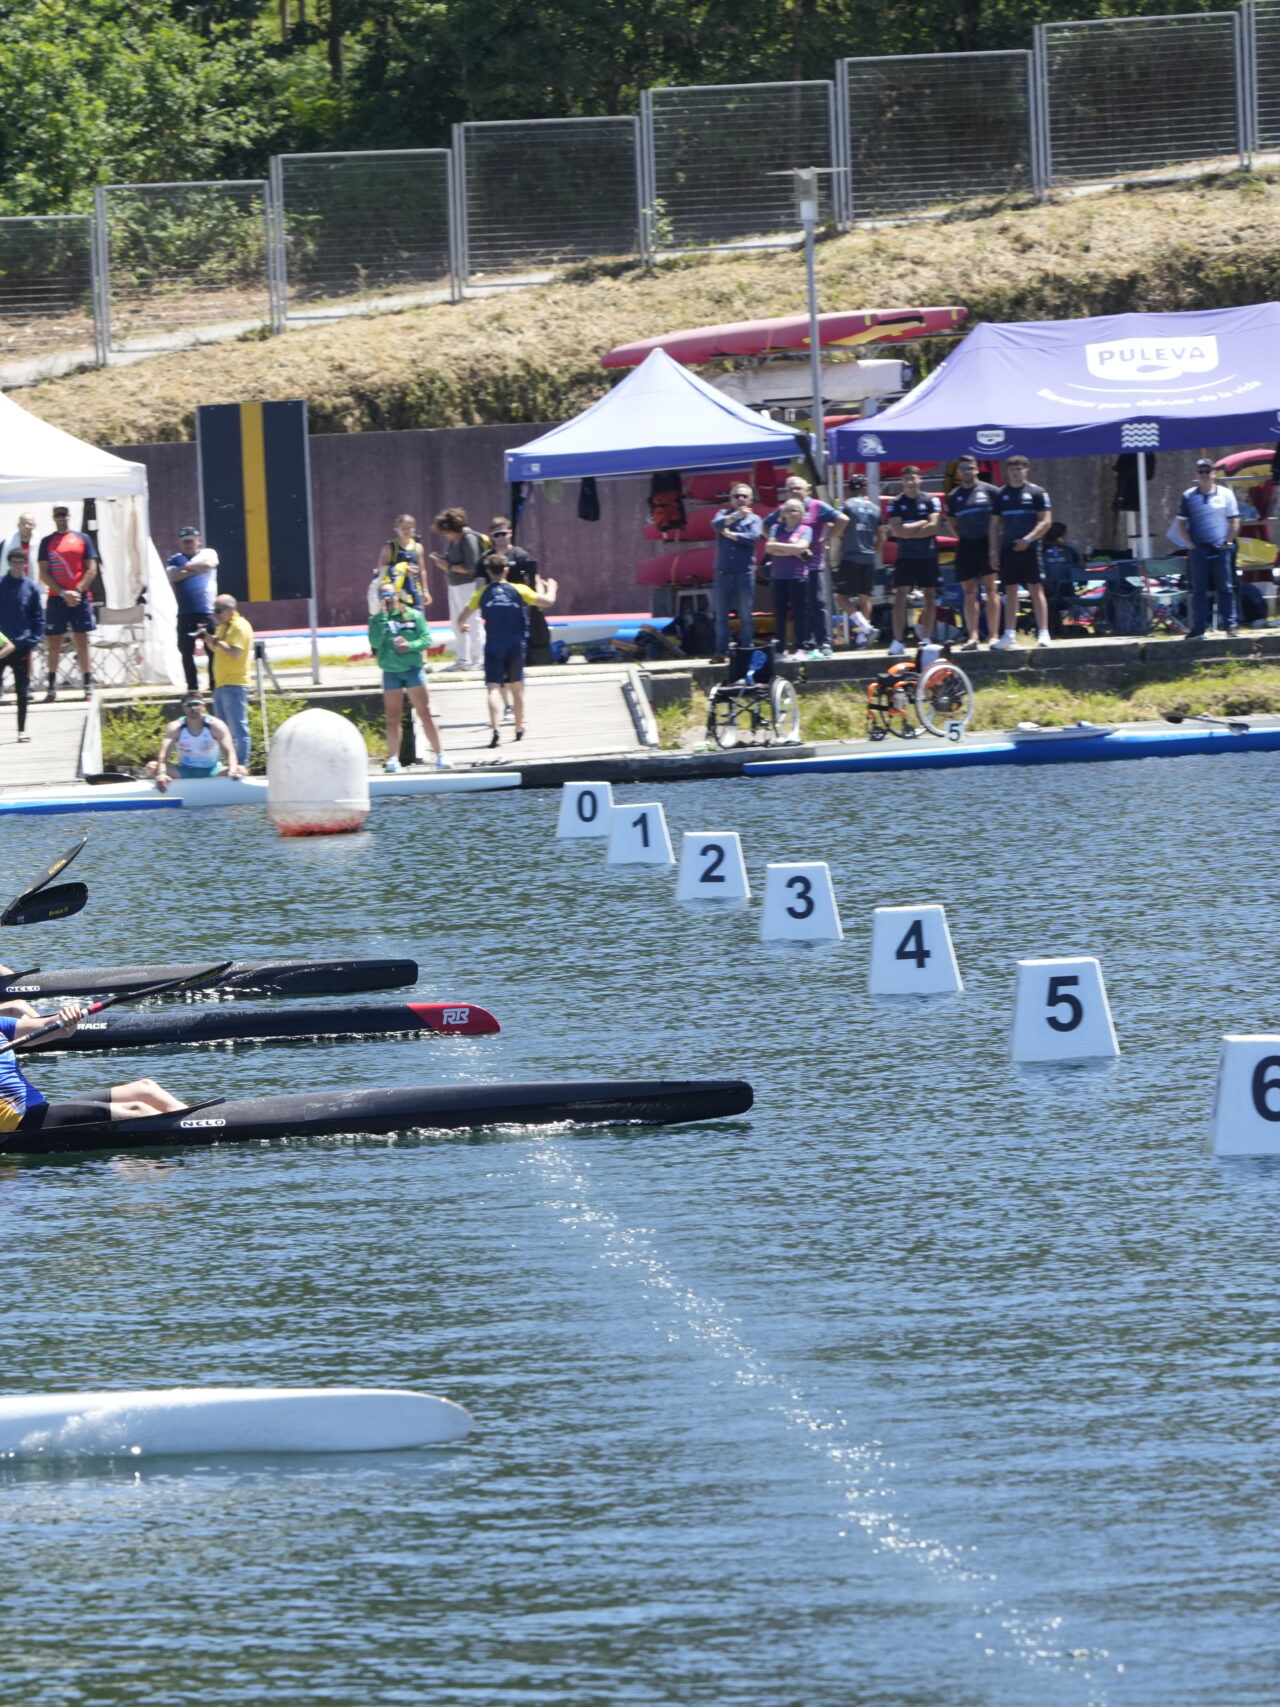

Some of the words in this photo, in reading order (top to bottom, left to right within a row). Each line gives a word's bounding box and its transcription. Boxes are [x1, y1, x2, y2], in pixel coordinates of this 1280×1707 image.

[1098, 347, 1205, 365] PULEVA
[949, 723, 960, 741] 5
[577, 790, 597, 822] 0
[632, 812, 650, 848] 1
[700, 844, 725, 883] 2
[786, 875, 814, 919] 3
[895, 920, 931, 968] 4
[1046, 975, 1083, 1032] 5
[1251, 1055, 1280, 1122] 6
[182, 1119, 225, 1128] NELO
